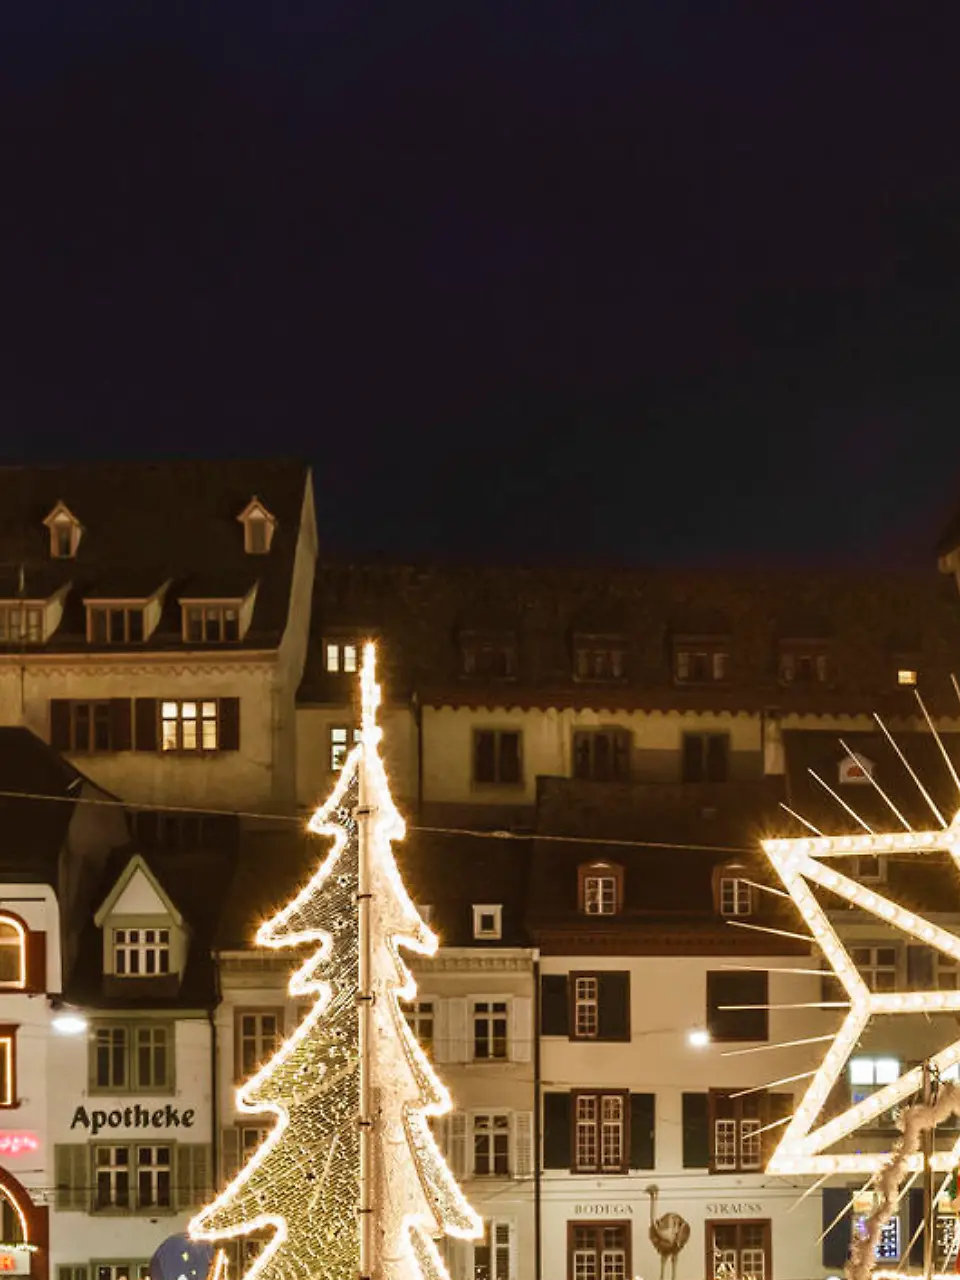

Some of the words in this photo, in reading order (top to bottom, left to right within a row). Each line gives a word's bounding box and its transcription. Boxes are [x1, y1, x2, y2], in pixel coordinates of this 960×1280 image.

[70, 1104, 195, 1135] Apotheke
[574, 1203, 634, 1215] BODEGA
[705, 1203, 763, 1214] STRAUSS
